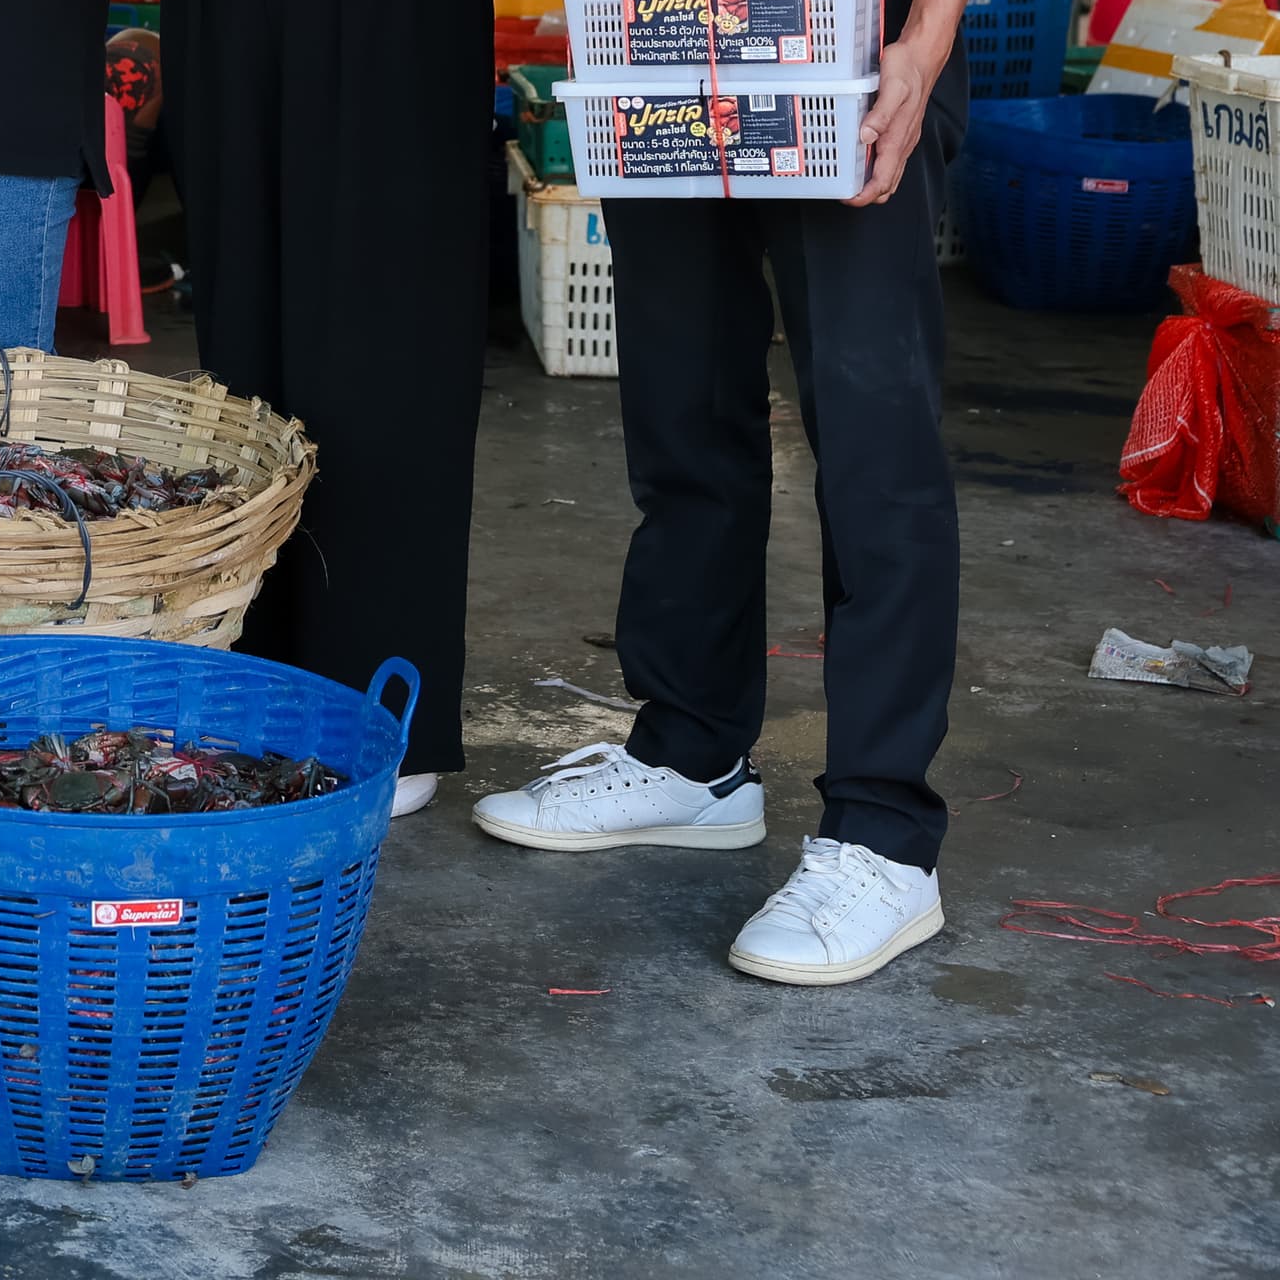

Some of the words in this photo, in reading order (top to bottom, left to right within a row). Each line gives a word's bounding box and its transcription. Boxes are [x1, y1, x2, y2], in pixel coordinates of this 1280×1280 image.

[629, 26, 652, 36] ขนาด
[660, 26, 676, 34] 5-8
[679, 25, 709, 36] ตัว/กก
[746, 37, 774, 46] 100%
[688, 49, 720, 60] กิโลกม
[629, 104, 702, 135] ปูทะเล
[621, 139, 645, 149] ขนาด
[652, 139, 669, 148] 5-8
[739, 149, 766, 158] 100%
[121, 905, 176, 922] Superstar
